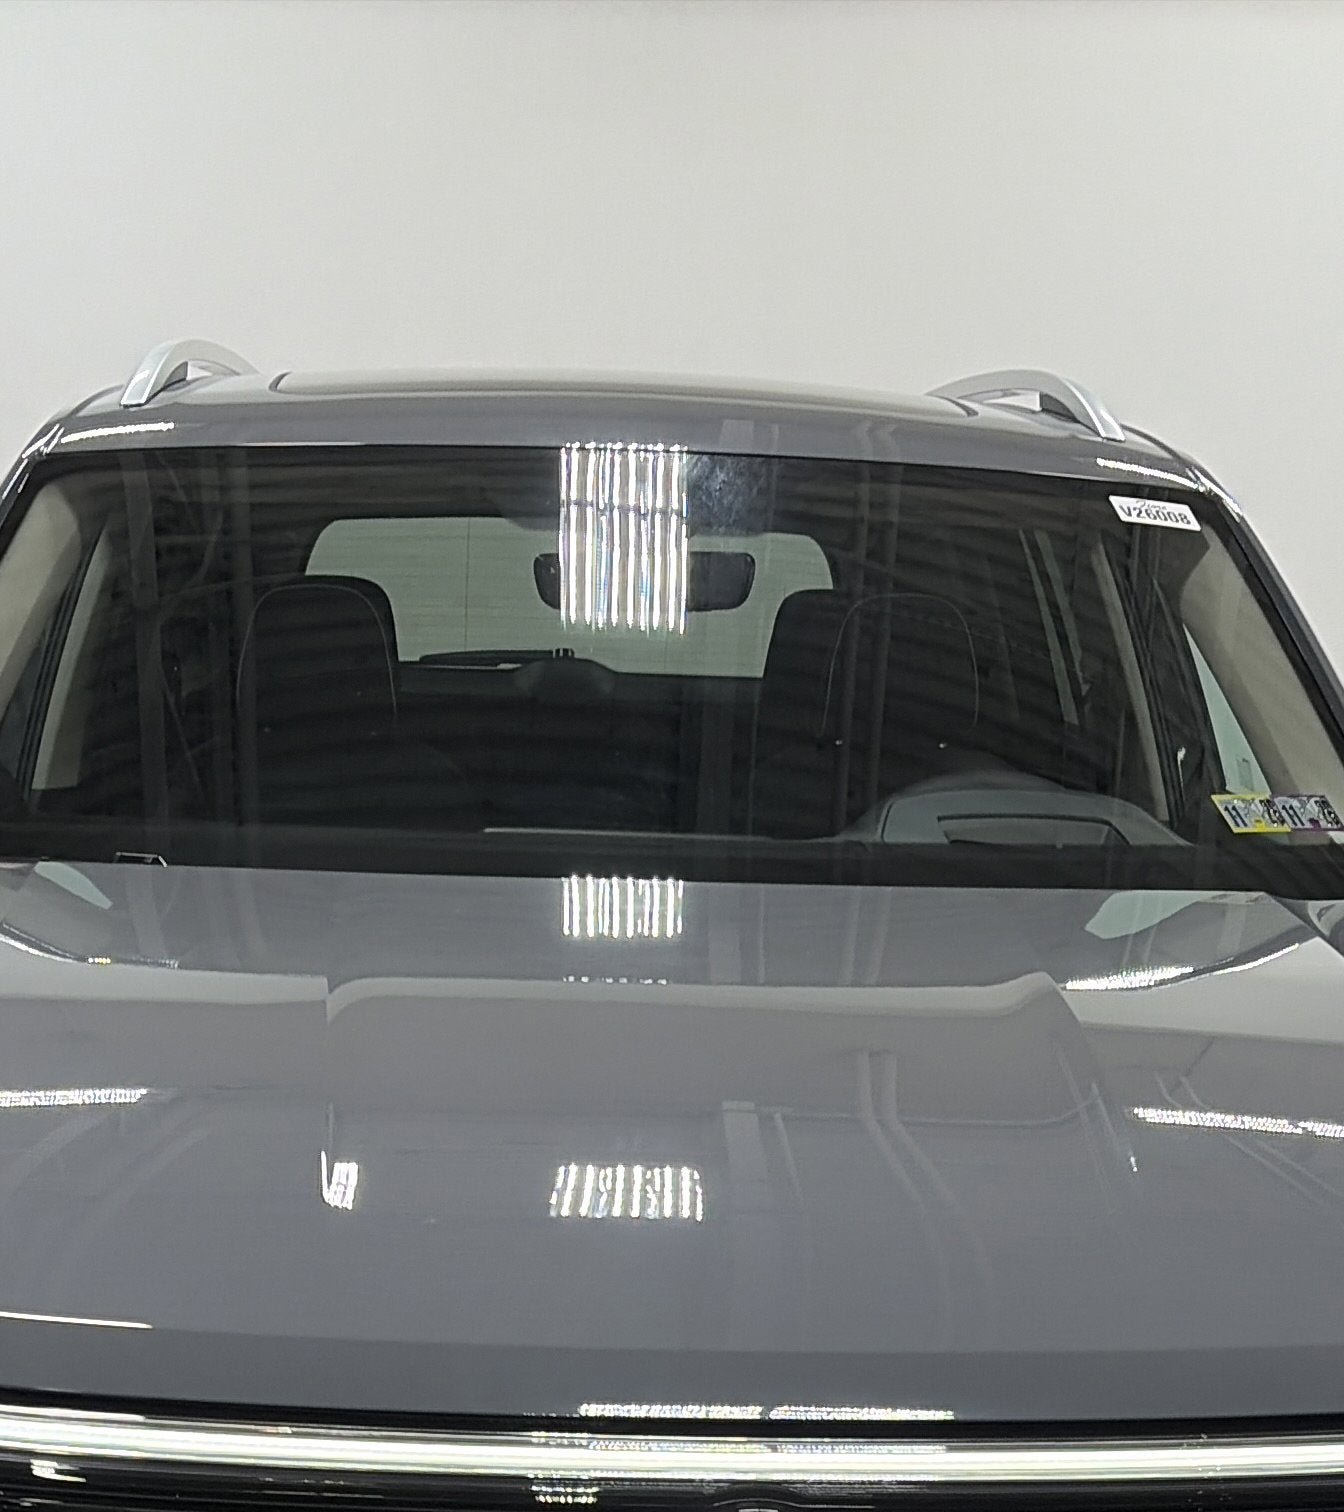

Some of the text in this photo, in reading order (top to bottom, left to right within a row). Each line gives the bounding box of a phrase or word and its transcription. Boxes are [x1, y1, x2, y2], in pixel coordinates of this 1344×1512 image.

[1119, 504, 1191, 525] V26008
[1223, 805, 1248, 827] 11
[1281, 804, 1306, 827] 11
